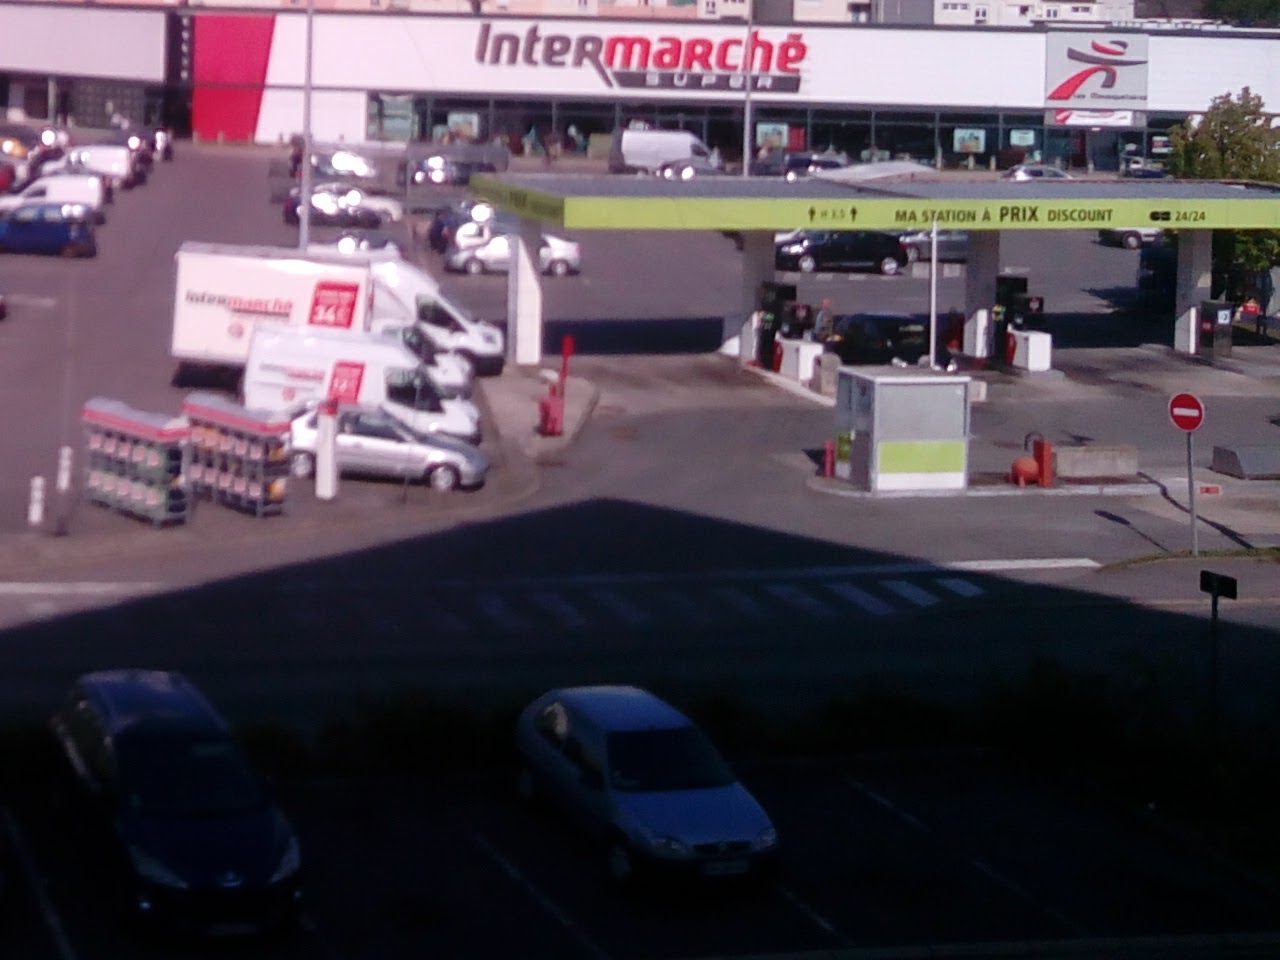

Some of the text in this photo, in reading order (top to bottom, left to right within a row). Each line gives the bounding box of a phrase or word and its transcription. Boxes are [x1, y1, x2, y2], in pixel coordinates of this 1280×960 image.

[475, 23, 807, 88] Intermarché
[645, 71, 773, 89] SUPER
[894, 209, 918, 223] MA
[921, 208, 976, 223] STATION
[999, 205, 1039, 223] PRIX
[1047, 208, 1113, 222] DISCOUNT
[1174, 210, 1206, 222] 24/24
